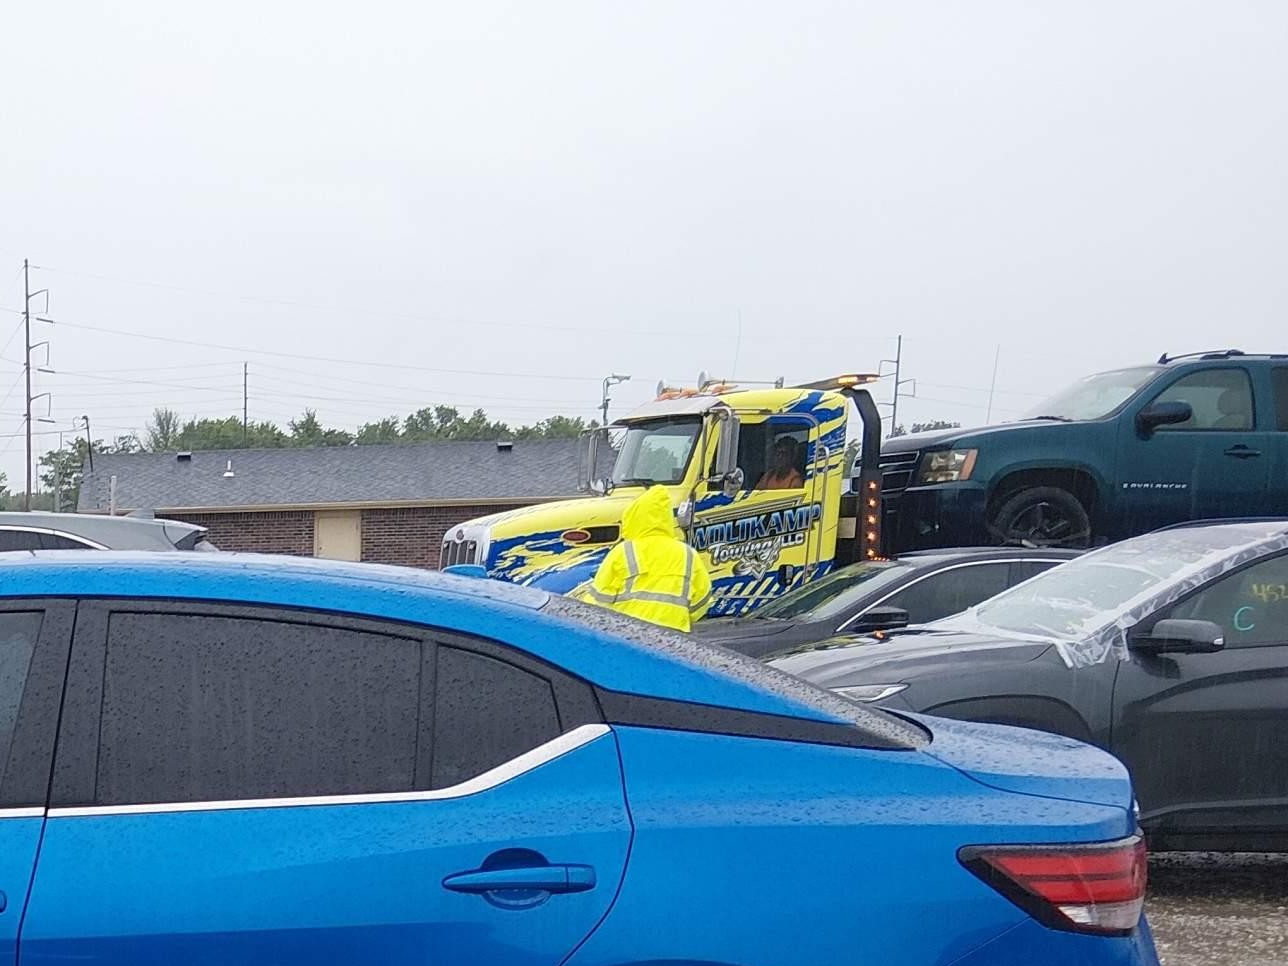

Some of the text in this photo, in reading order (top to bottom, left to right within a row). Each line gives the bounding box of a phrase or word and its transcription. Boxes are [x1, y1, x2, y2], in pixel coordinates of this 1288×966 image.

[1129, 482, 1188, 490] AVALANCHE
[689, 503, 822, 551] WOLTKAMP
[708, 532, 805, 565] Towing LLC
[1233, 605, 1256, 632] C
